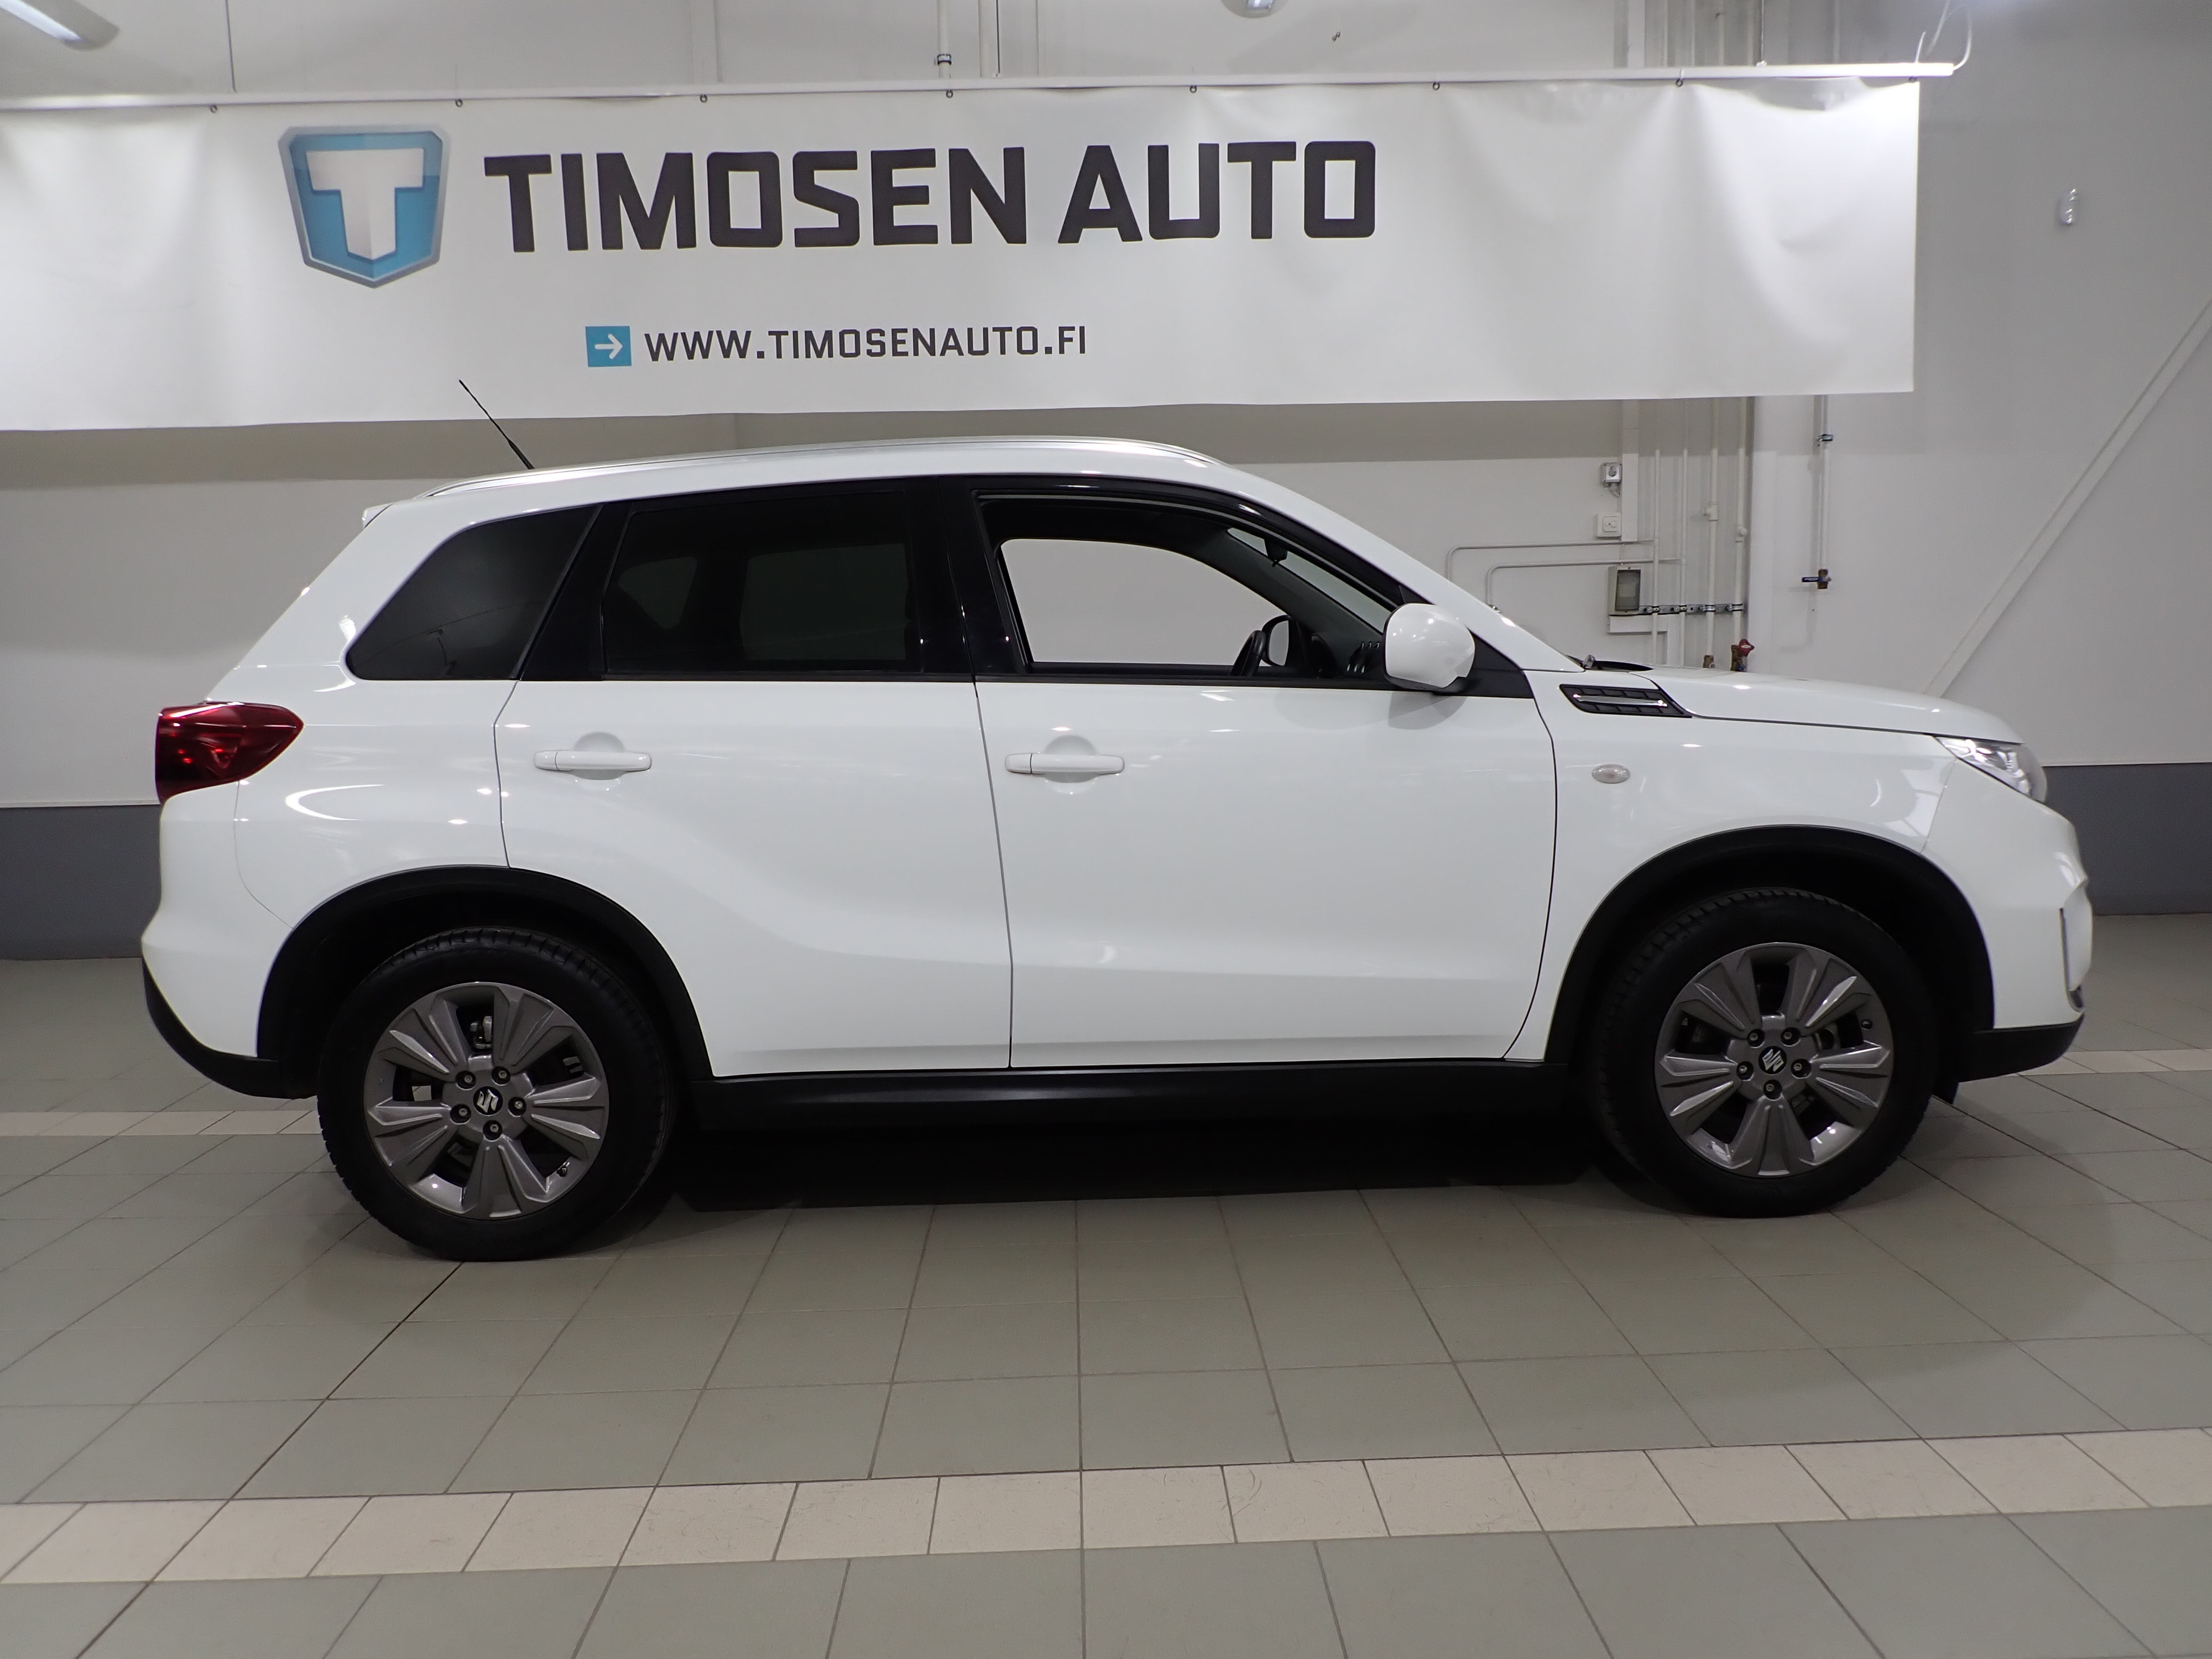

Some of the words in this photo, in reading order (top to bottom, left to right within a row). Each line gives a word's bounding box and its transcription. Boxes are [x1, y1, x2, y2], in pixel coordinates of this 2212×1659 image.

[483, 147, 1027, 253] TIMOSEN
[1057, 140, 1376, 244] AUTO
[644, 326, 1086, 362] WWW.TIMOSENAUTO.FI
